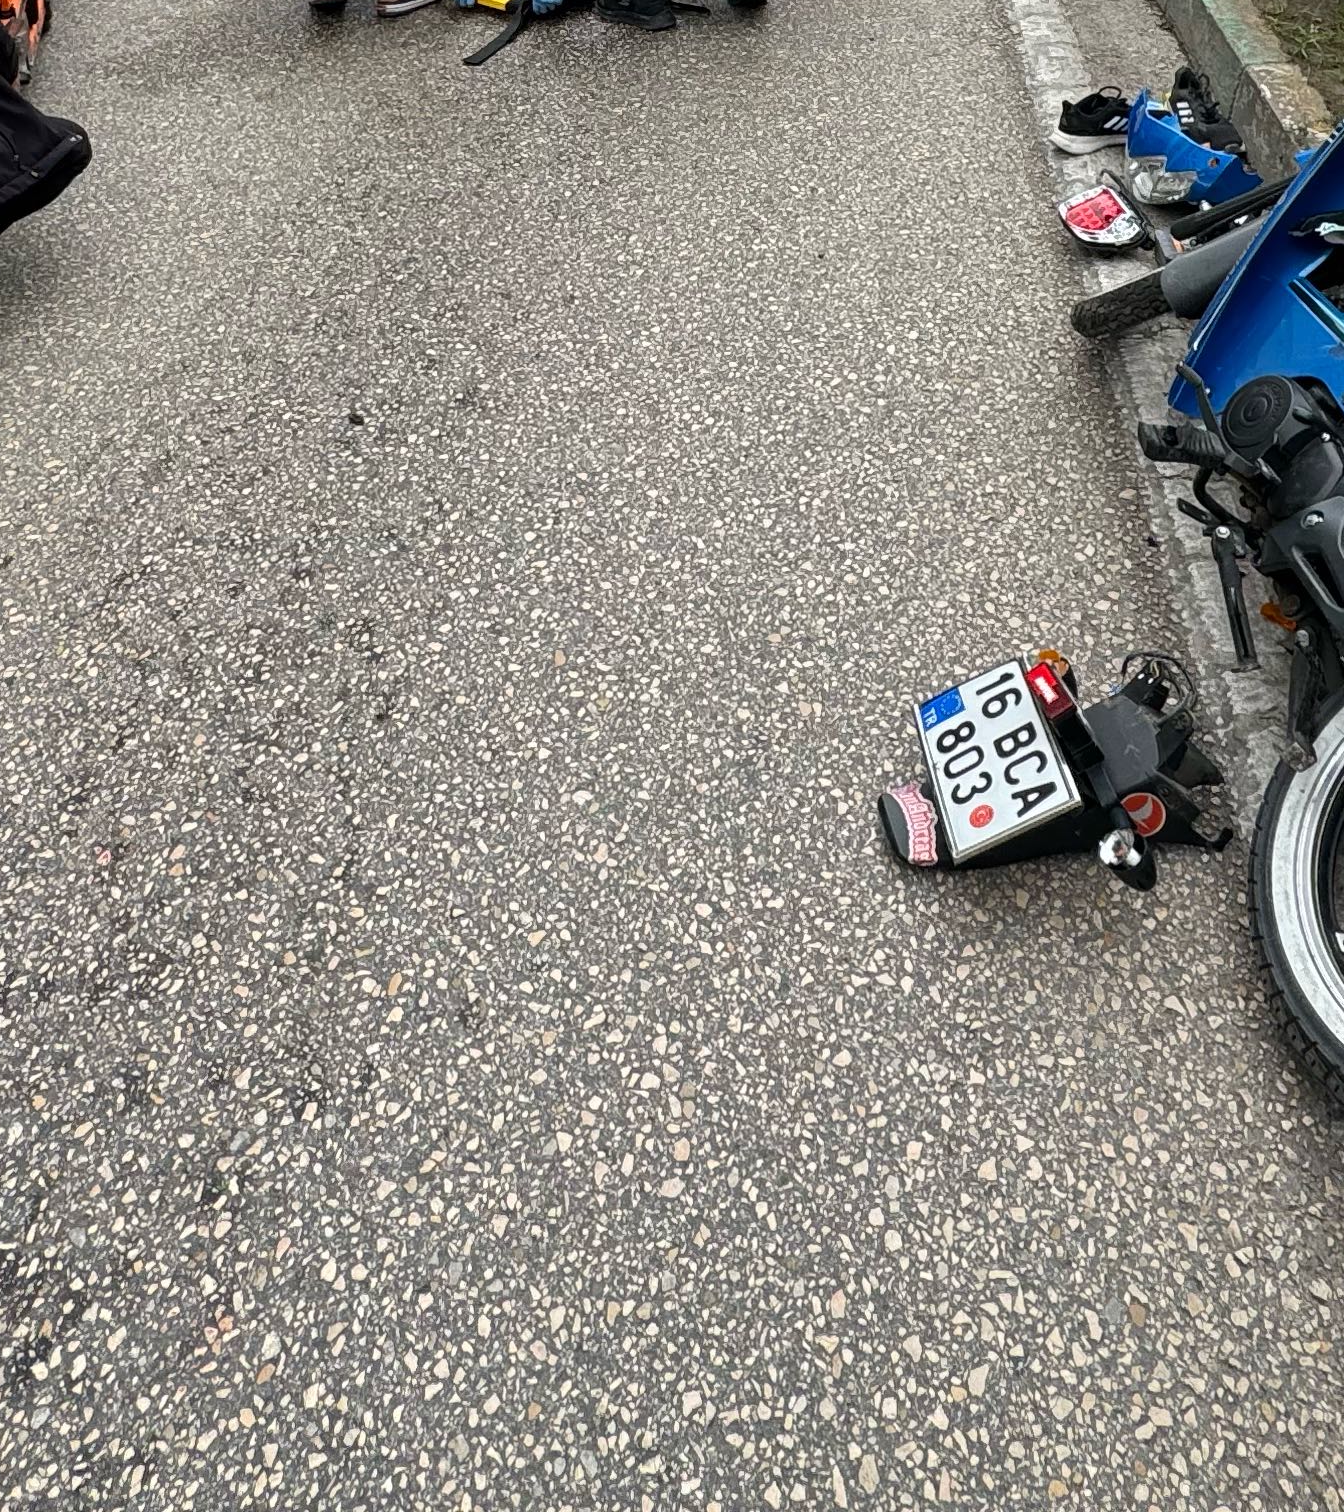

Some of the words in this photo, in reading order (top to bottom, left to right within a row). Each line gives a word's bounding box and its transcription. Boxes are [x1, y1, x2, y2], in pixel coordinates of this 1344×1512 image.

[976, 671, 1022, 719] 16
[936, 720, 994, 806] 803
[994, 720, 1059, 818] BCA
